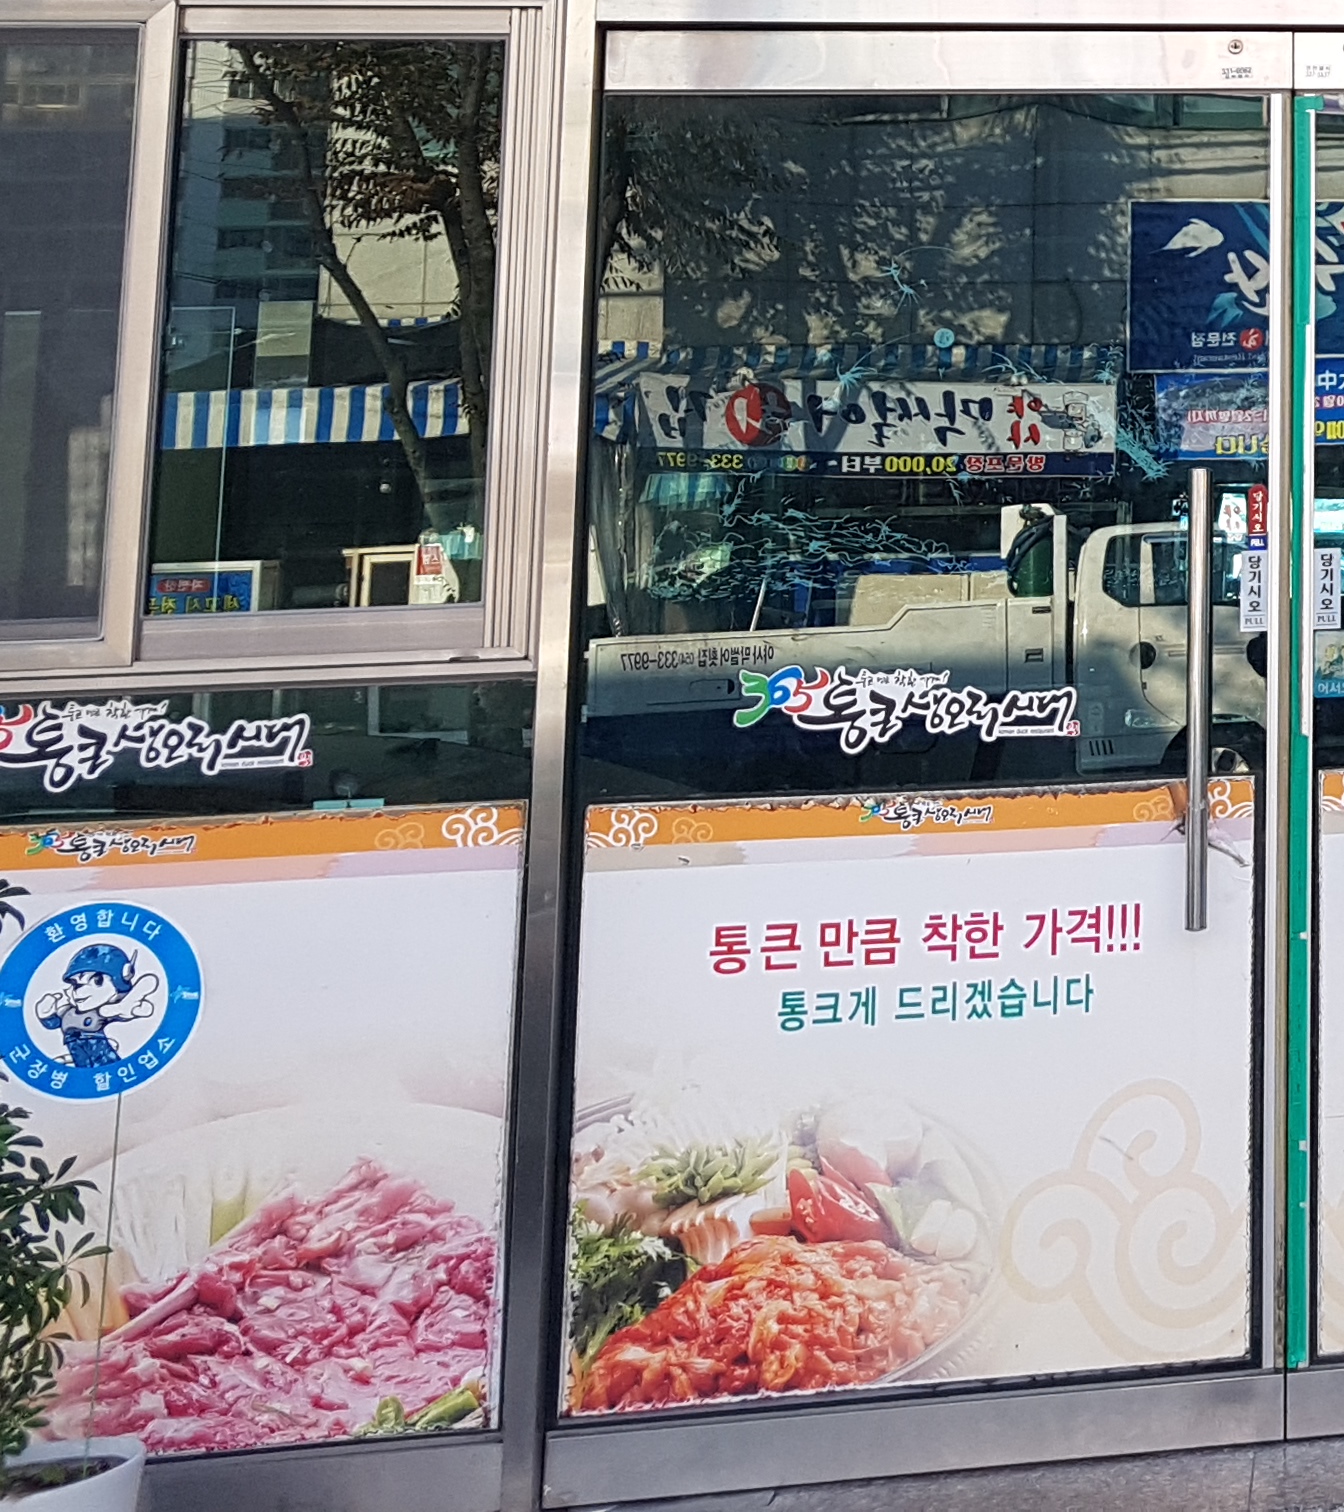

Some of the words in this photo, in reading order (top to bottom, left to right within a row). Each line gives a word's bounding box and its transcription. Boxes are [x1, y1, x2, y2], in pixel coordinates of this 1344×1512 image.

[1252, 491, 1264, 532] 당기시오
[1248, 556, 1262, 613] 당기시오
[1320, 553, 1334, 610] 당기시오
[1244, 617, 1264, 625] PULL
[1317, 615, 1336, 623] PULL
[113, 722, 223, 771] 생오리
[227, 718, 305, 762] 시대
[44, 909, 163, 943] 환영합니다
[709, 922, 802, 974] 통큰
[819, 916, 901, 967] 만큼
[922, 910, 1004, 962] 착한
[1024, 903, 1142, 955] 가격!!!
[777, 985, 876, 1032] 통크게
[894, 973, 1094, 1021] 드리겠습니다
[9, 1044, 69, 1090] 군장병
